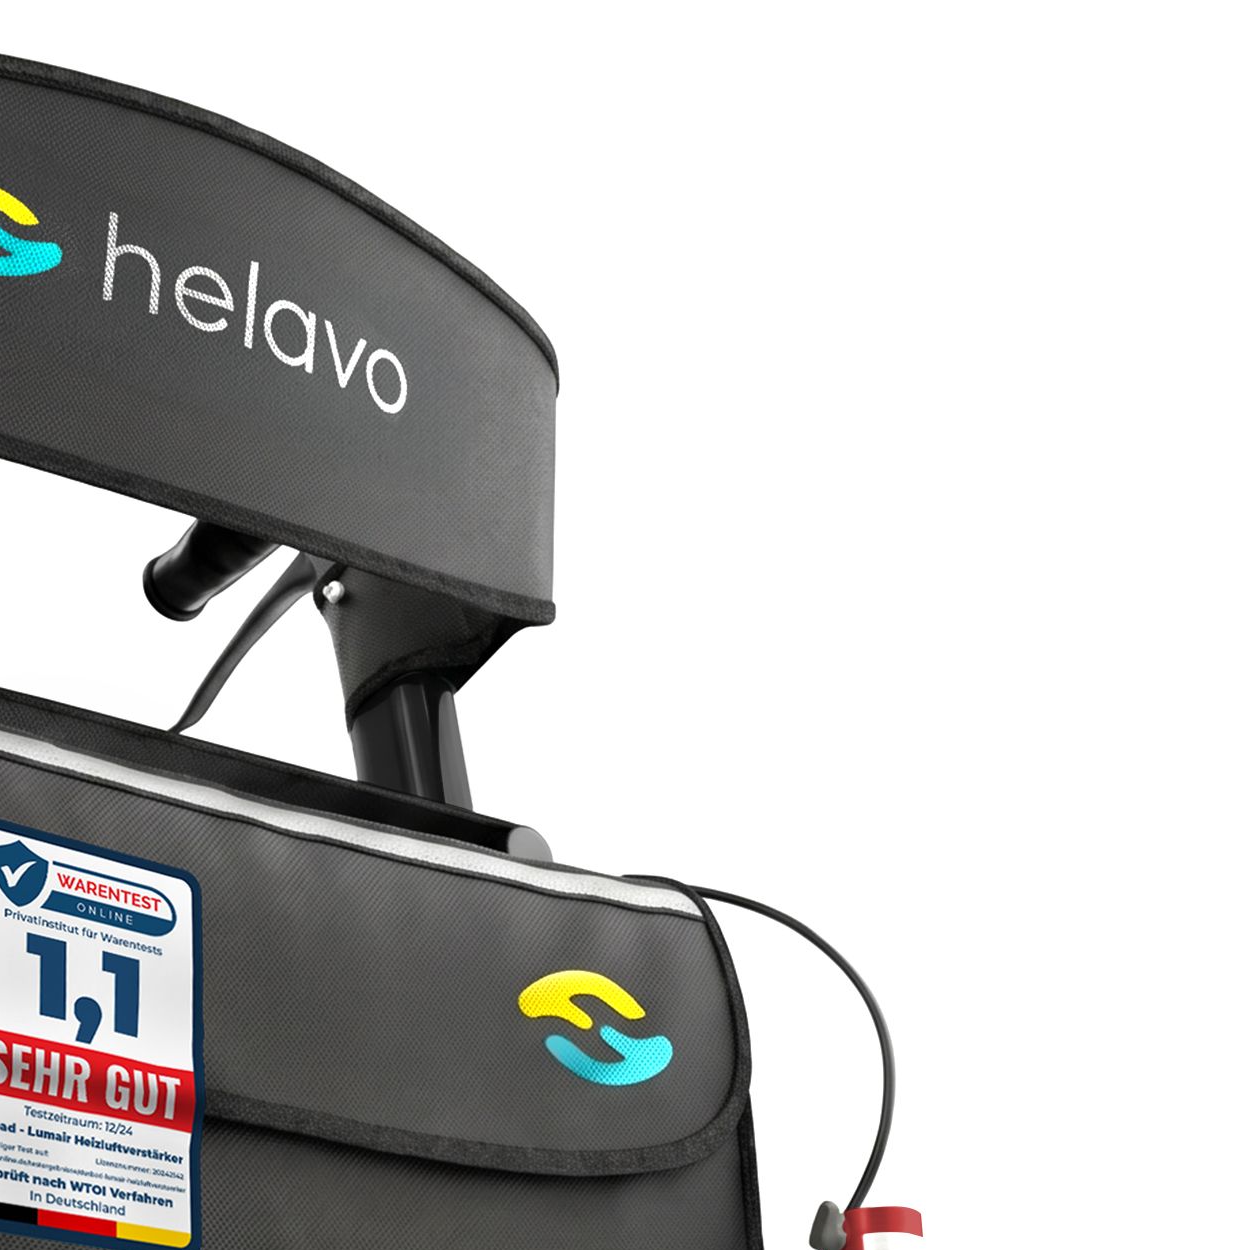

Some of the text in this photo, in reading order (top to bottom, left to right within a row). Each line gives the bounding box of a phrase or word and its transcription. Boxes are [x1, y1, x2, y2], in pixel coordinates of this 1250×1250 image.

[103, 211, 407, 414] helavo
[57, 872, 161, 912] WARENTEST
[4, 907, 163, 956] Privatinstitut für Warentests
[77, 902, 133, 925] ONLINE
[26, 932, 140, 1044] 1,1
[105, 1064, 181, 1121] GUT
[24, 1105, 133, 1136] Testzeitraum: 12/24
[17, 1145, 34, 1154] Test
[27, 1126, 71, 1144] Lumair
[74, 1135, 184, 1165] Heizluftverstärker
[30, 1190, 126, 1216] In Deutschland
[32, 1176, 66, 1190] nach
[70, 1180, 107, 1196] WTOI
[109, 1186, 174, 1208] Verfahren
